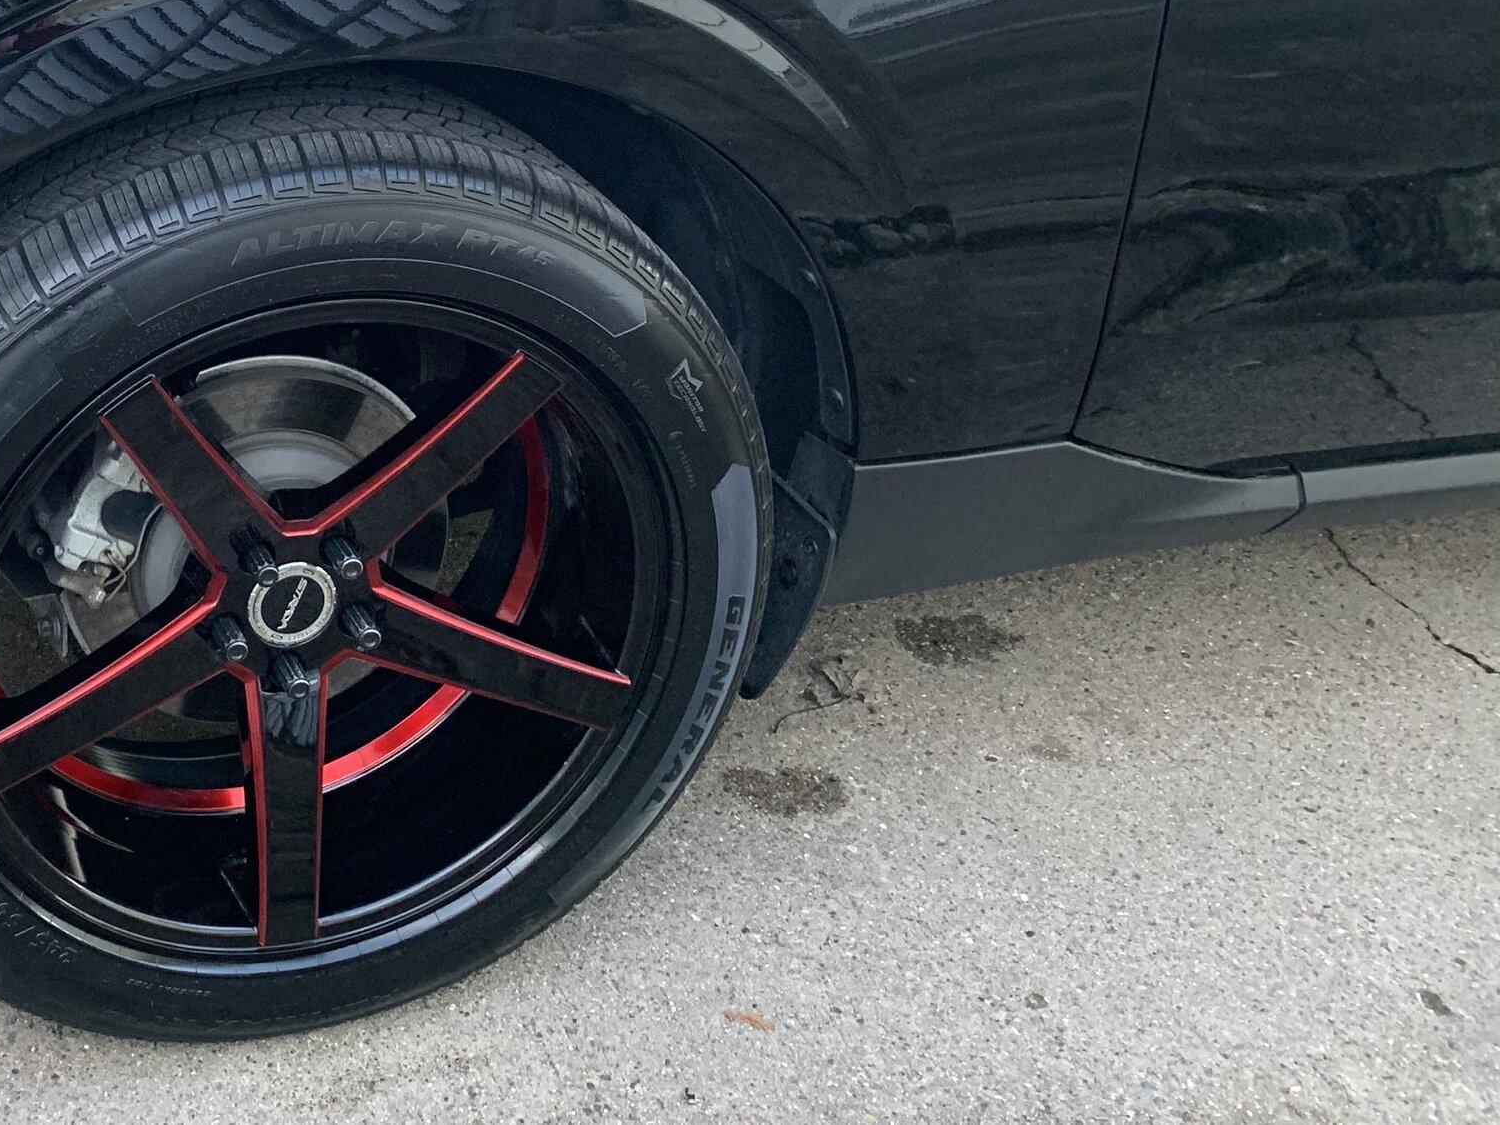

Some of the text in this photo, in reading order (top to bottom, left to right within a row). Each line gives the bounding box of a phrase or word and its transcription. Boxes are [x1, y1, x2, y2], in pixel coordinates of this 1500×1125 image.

[231, 219, 446, 266] ALTIMAX
[673, 379, 707, 433] TECHNOLOGY
[277, 577, 308, 630] STRADA
[641, 594, 746, 814] GENERAL
